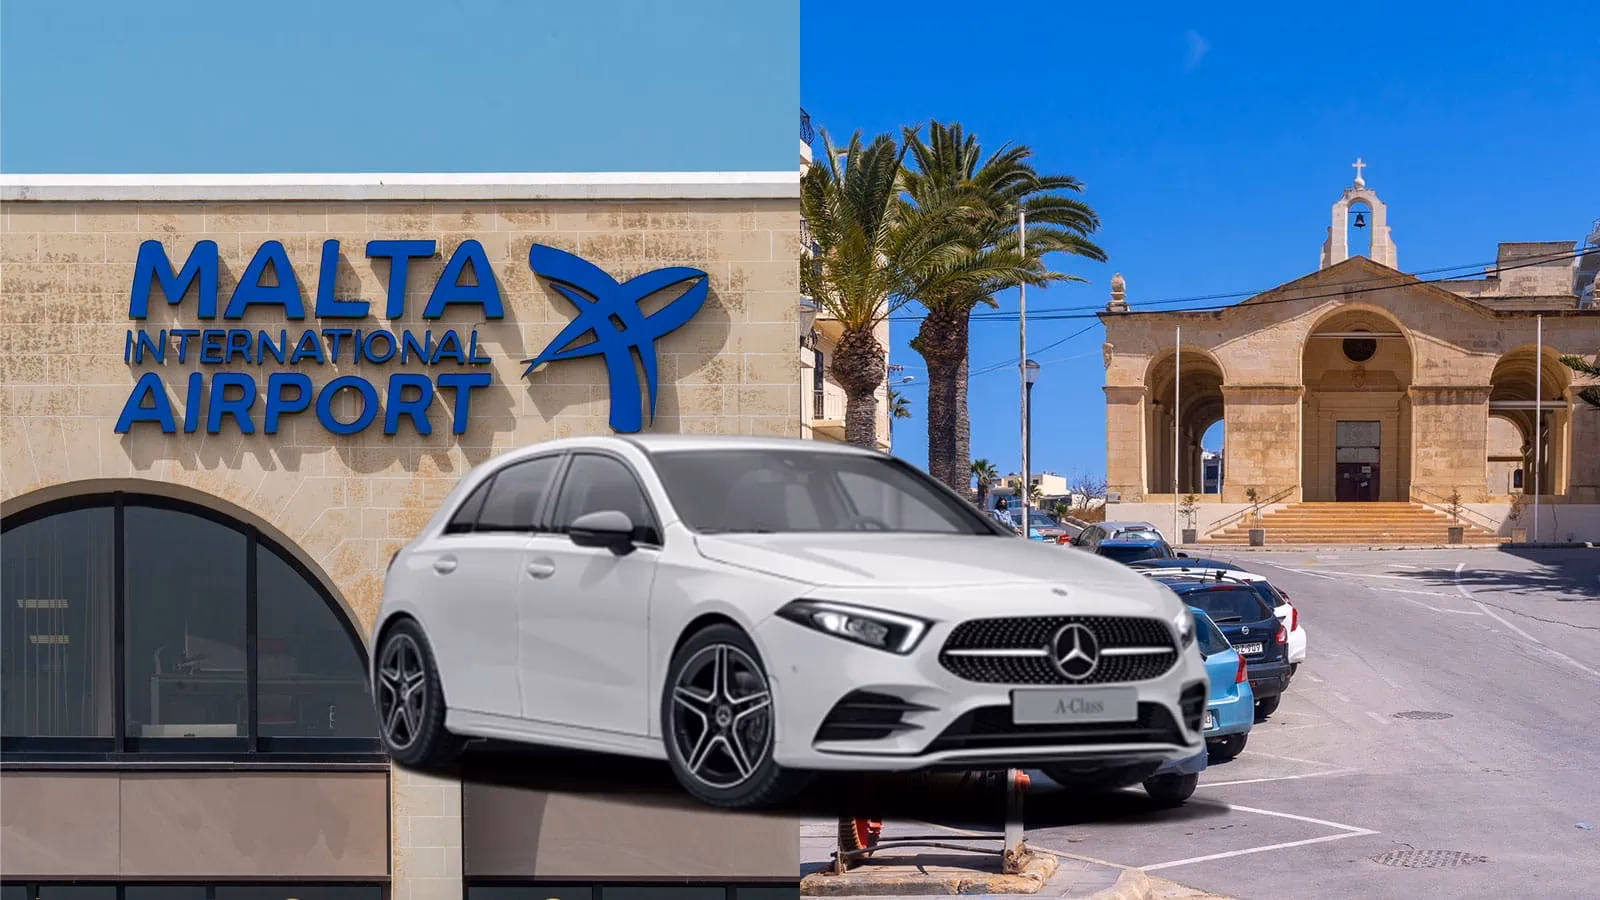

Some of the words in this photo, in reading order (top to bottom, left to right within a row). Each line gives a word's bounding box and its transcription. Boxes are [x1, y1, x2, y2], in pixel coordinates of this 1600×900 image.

[129, 239, 504, 319] MALTA
[124, 328, 492, 365] INTERNATIONAL
[114, 371, 492, 435] AIRPORT
[1056, 698, 1104, 715] A-Class
